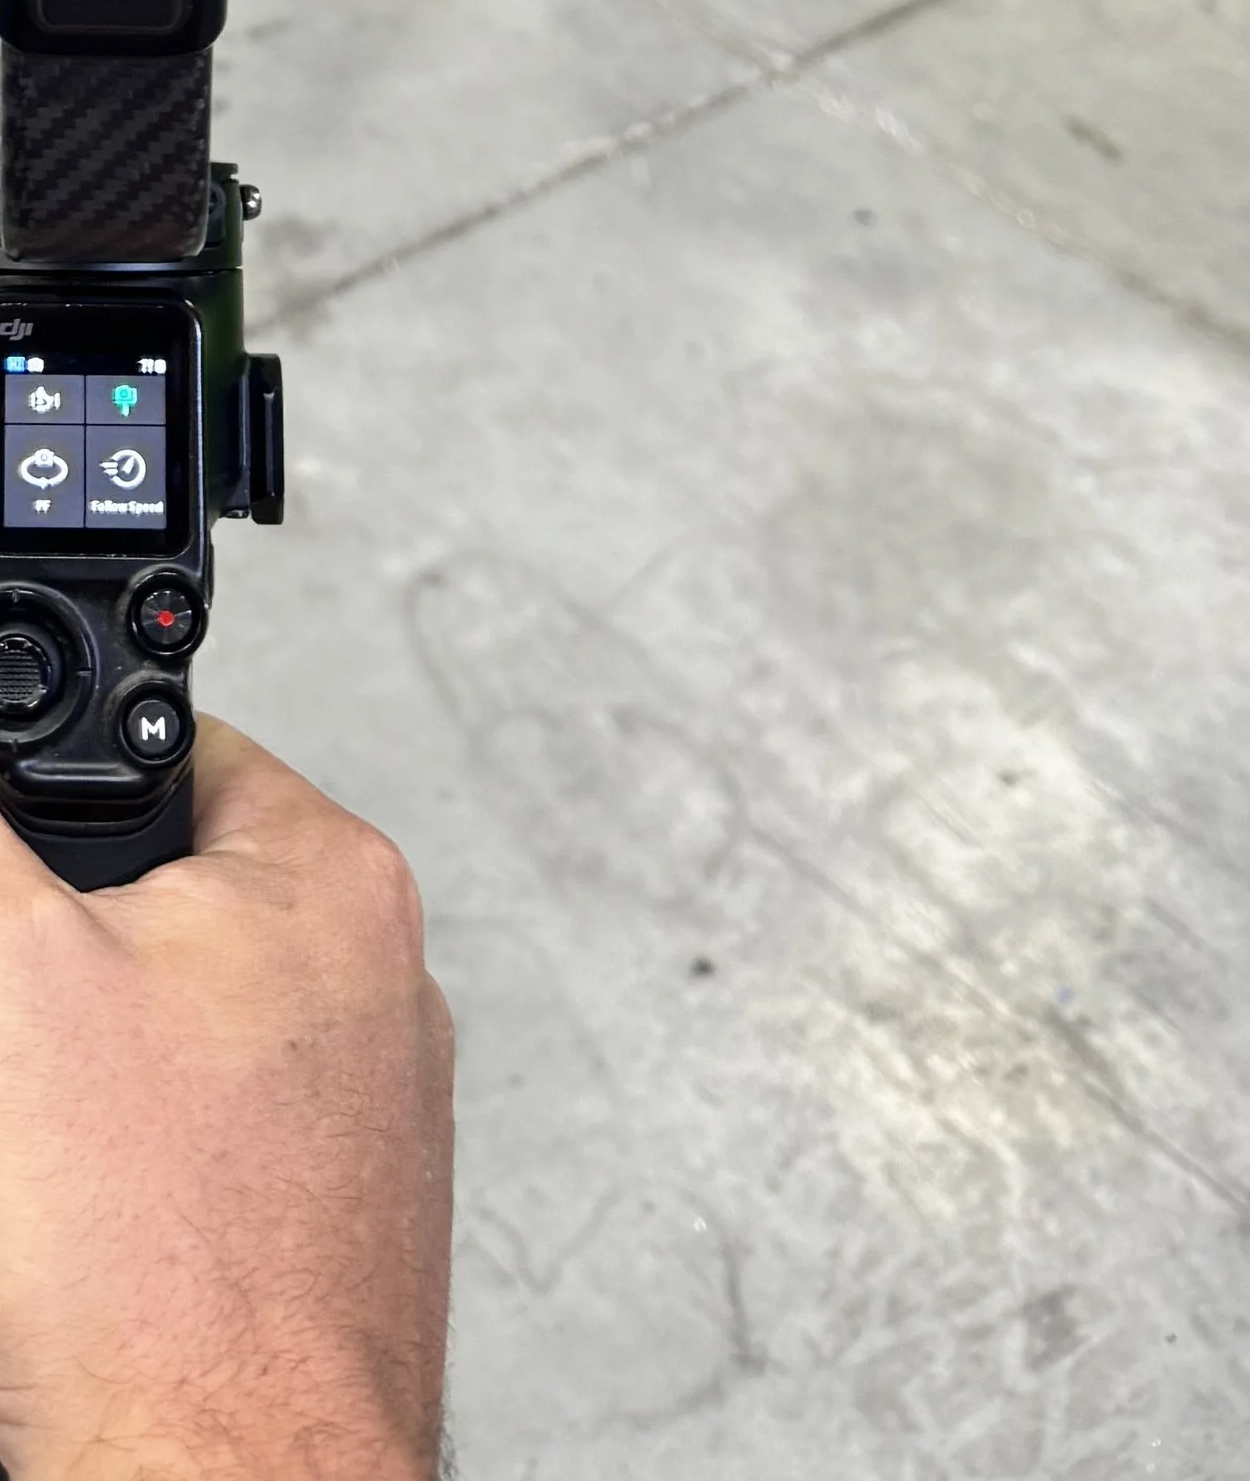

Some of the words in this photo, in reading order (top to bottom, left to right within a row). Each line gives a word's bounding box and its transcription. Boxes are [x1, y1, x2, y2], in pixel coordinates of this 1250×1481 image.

[89, 499, 128, 514] Follow
[128, 499, 165, 518] Speed
[141, 716, 166, 741] M
